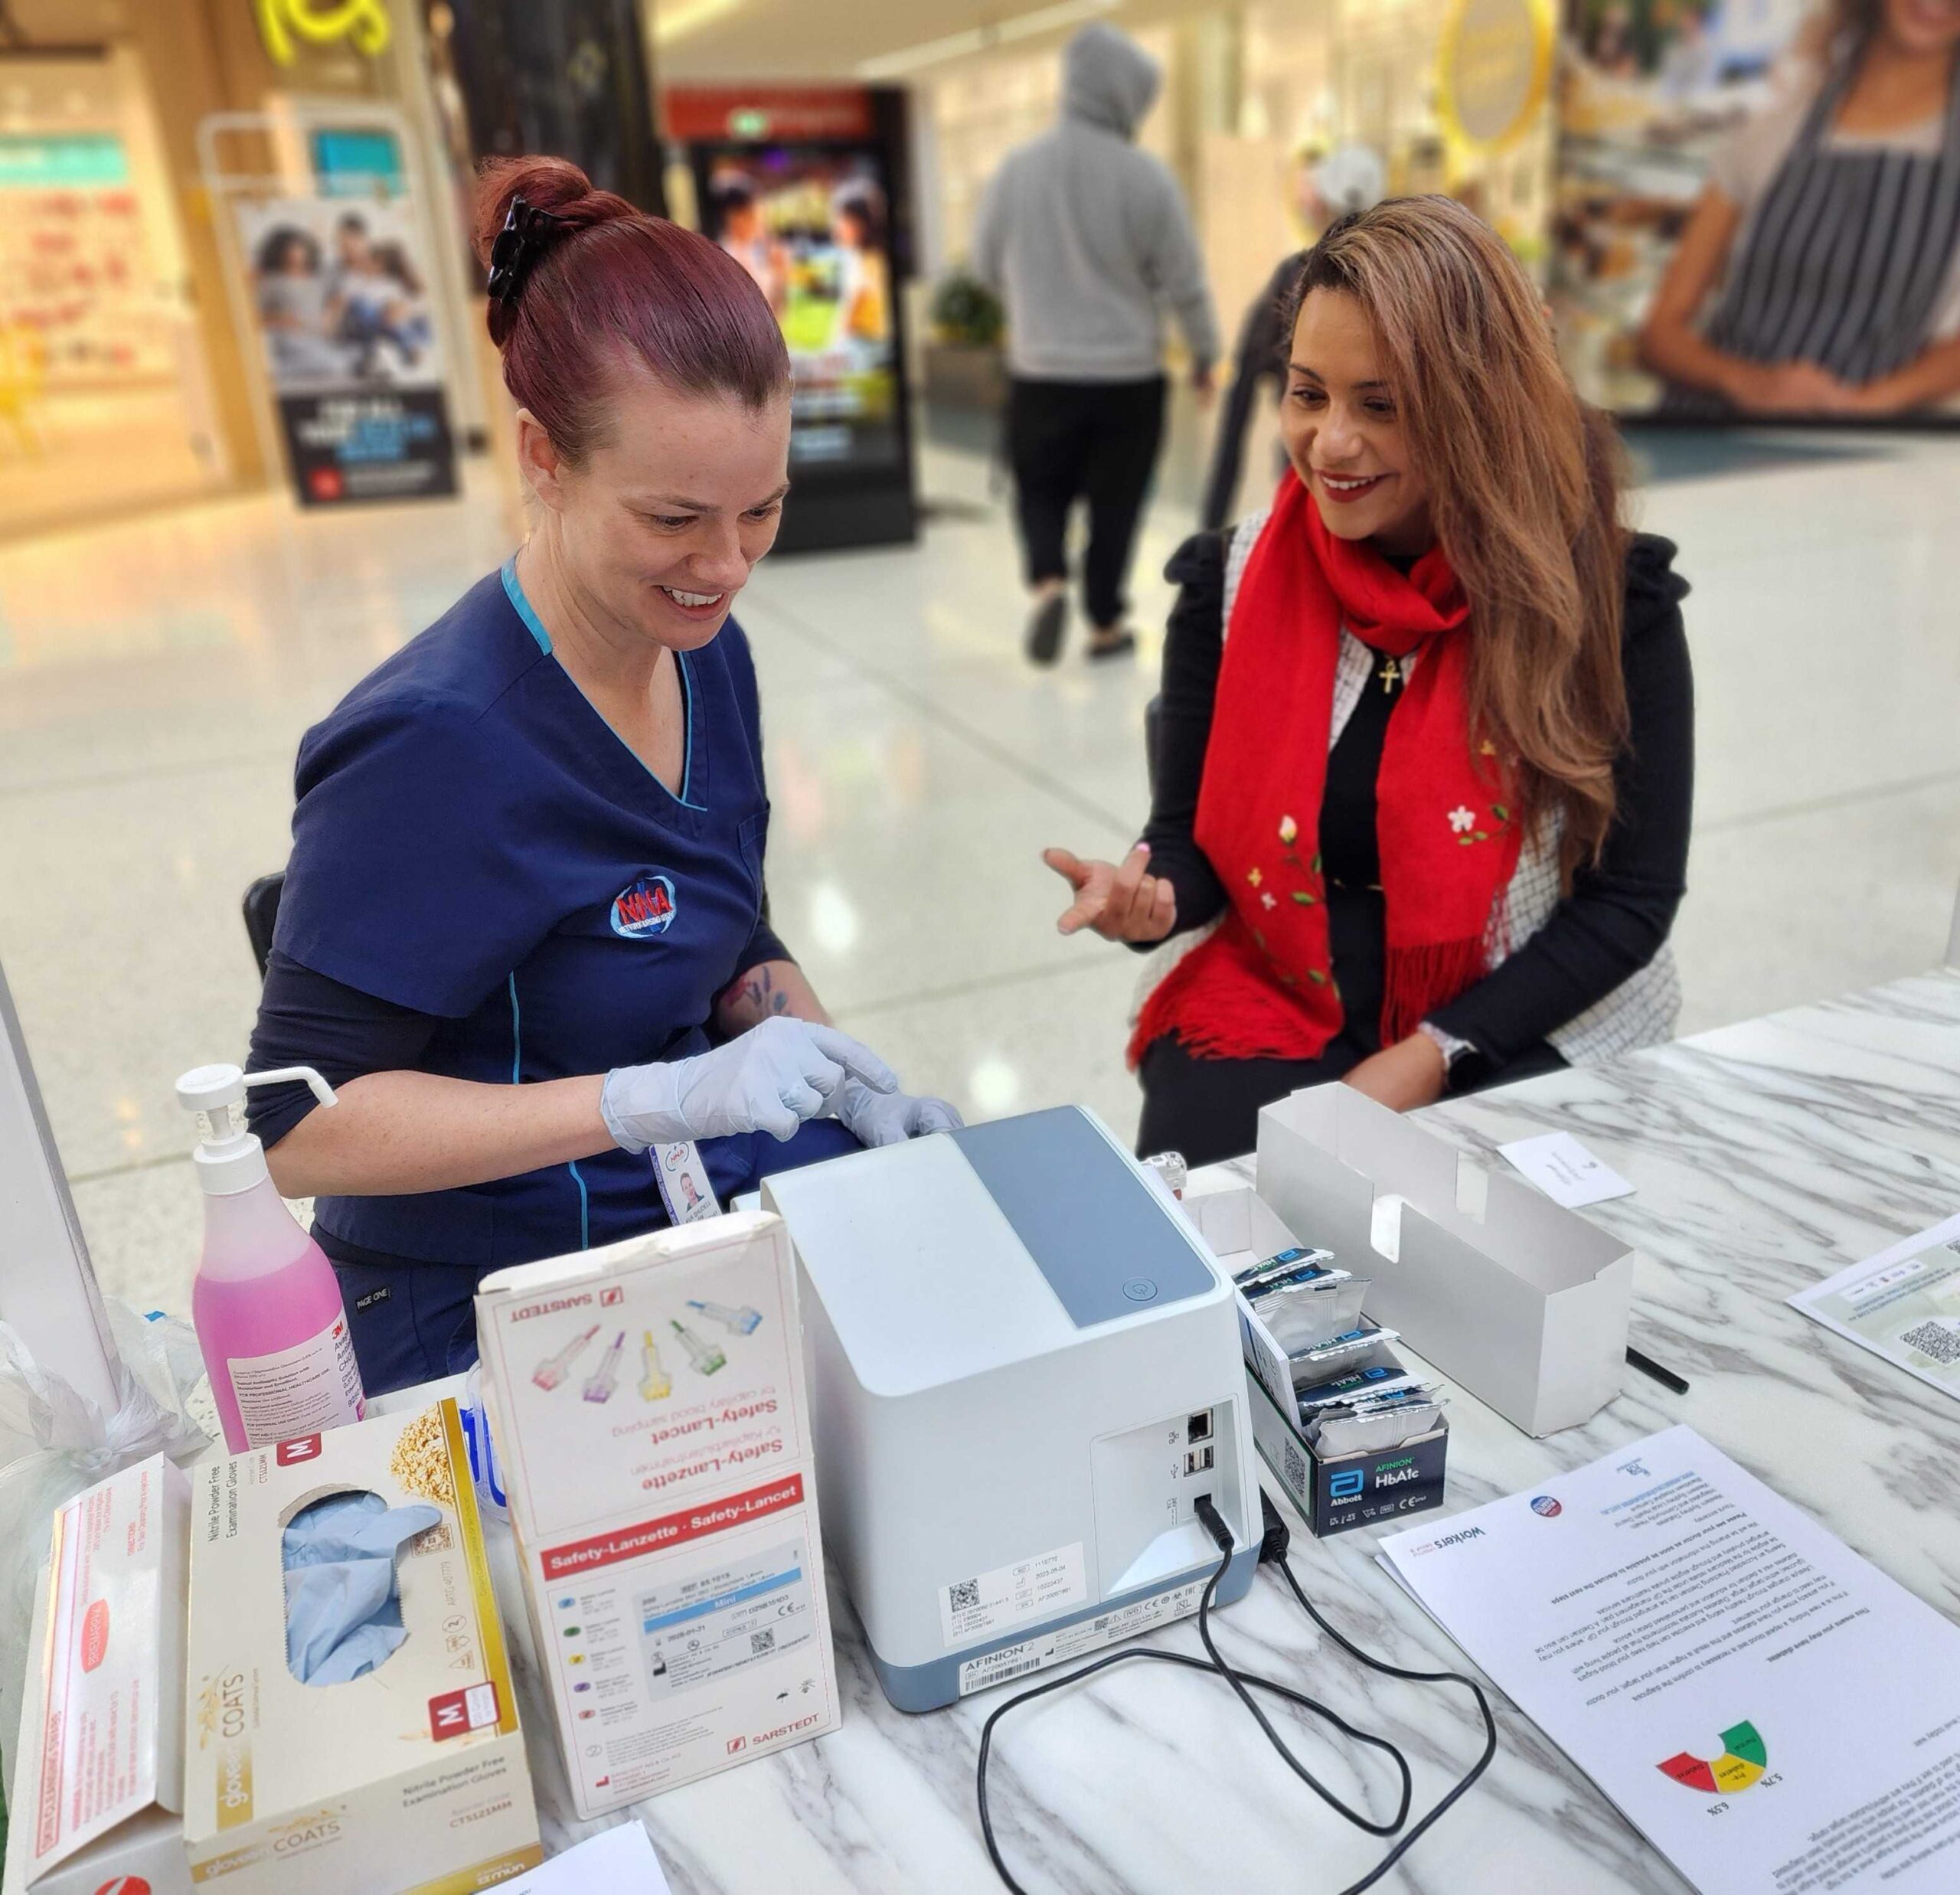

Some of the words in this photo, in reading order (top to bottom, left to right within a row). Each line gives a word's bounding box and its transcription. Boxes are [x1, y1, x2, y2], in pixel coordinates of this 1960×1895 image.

[356, 1295, 372, 1309] PAGE
[373, 1289, 387, 1301] ONE
[511, 1295, 592, 1322] SARSTEDT
[332, 1321, 344, 1340] 3M
[708, 1390, 760, 1411] capillary
[670, 1402, 704, 1422] blood
[612, 1409, 667, 1438] sampling
[652, 1400, 778, 1446] Safety-Lancet
[286, 1439, 313, 1459] M
[208, 1465, 220, 1483] Free
[226, 1461, 237, 1487] Gloves
[642, 1439, 783, 1491] Safety-Lanzette
[1375, 1458, 1413, 1473] AFINION
[1375, 1469, 1419, 1488] HbA1c
[207, 1485, 220, 1514] Powder
[1331, 1494, 1363, 1507] Abbott
[225, 1487, 238, 1537] Examination
[207, 1515, 220, 1541] Nitrile
[550, 1524, 679, 1570] Safety-Lanzette
[691, 1485, 797, 1530] Safety-Lancet
[1435, 1525, 1486, 1550] Workers
[714, 1596, 737, 1609] Mini
[1855, 1606, 1870, 1617] This
[1821, 1623, 1834, 1633] you
[1834, 1614, 1856, 1627] means
[1793, 1638, 1810, 1649] have
[1807, 1630, 1822, 1640] may
[965, 1645, 1024, 1672] AFINION
[221, 1674, 245, 1737] COATS
[439, 1701, 465, 1727] M
[753, 1714, 820, 1746] SARSTEDT
[403, 1778, 436, 1796] Nitrile
[439, 1763, 480, 1783] Powder
[482, 1756, 505, 1769] Free
[1677, 1763, 1704, 1779] Diabetes
[1719, 1763, 1745, 1779] diabetes
[1760, 1772, 1782, 1788] 5.7%
[403, 1779, 469, 1808] Examination
[471, 1766, 508, 1785] Gloves
[1707, 1801, 1729, 1816] 6.5%
[273, 1820, 341, 1852] COATS
